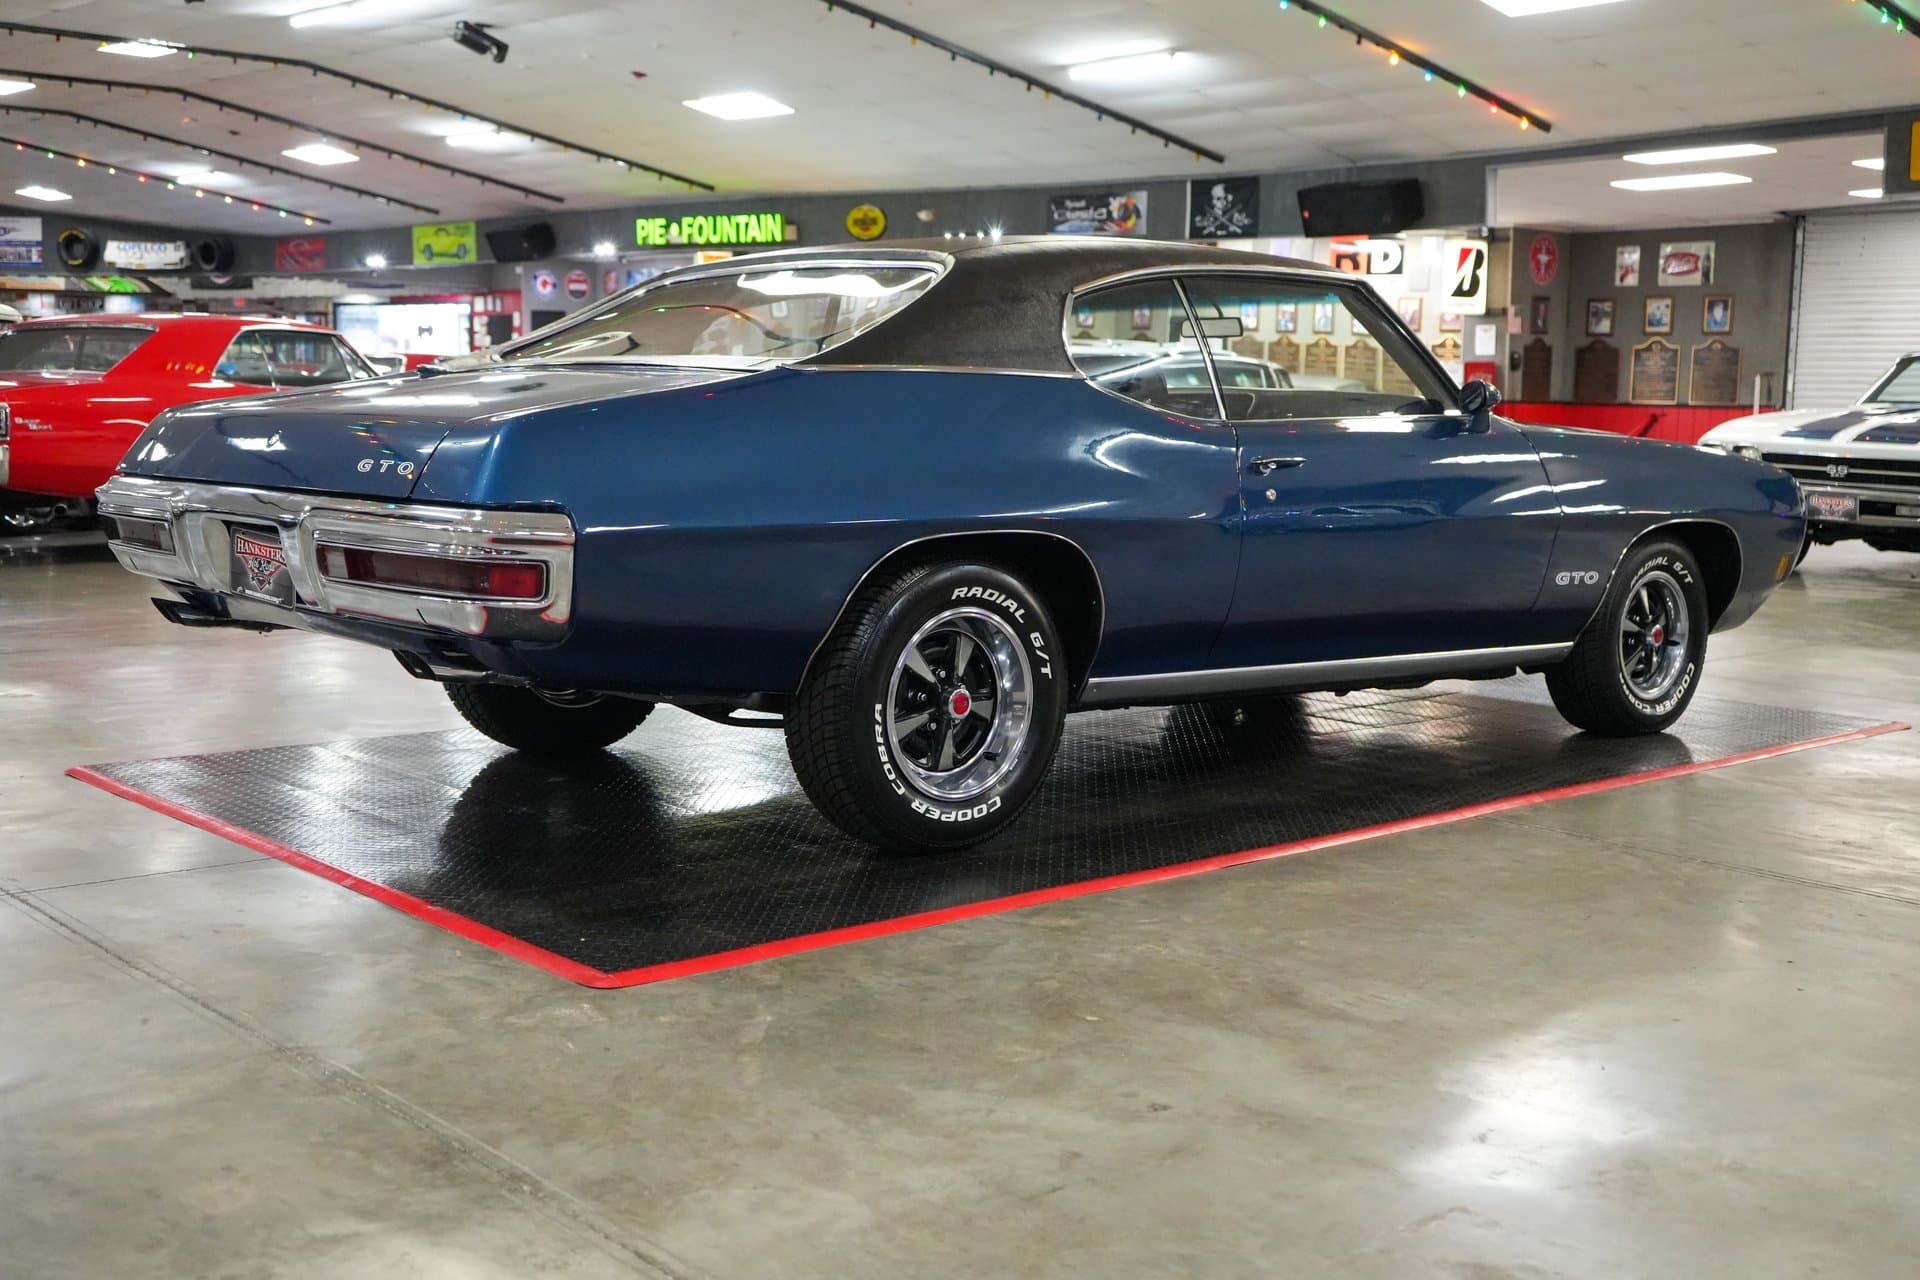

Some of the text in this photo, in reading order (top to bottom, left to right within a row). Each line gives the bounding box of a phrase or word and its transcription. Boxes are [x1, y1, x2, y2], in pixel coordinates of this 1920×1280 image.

[636, 213, 782, 245] PIE FOUNTAIN
[357, 458, 415, 475] GTO
[237, 538, 287, 563] HANKSTERS
[1555, 570, 1599, 586] GTO
[1673, 561, 1694, 584] G/T
[951, 586, 1053, 680] RADIAL G/T
[1656, 662, 1695, 713] COOPER
[873, 703, 1002, 822] COOPER COBRA
